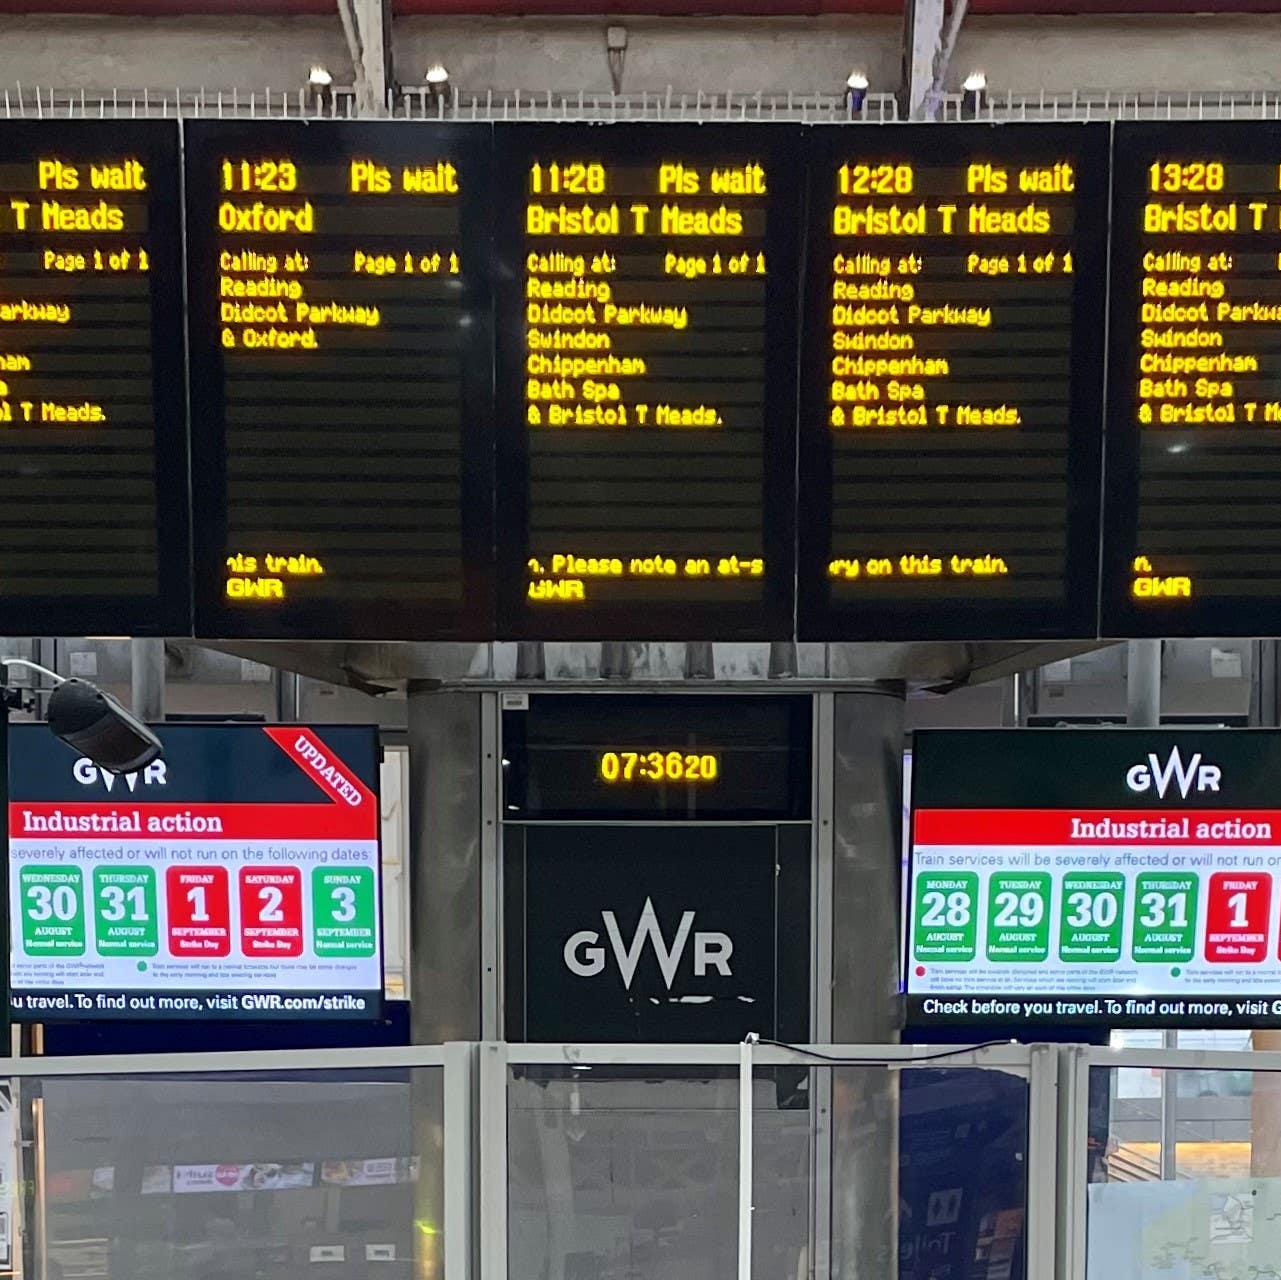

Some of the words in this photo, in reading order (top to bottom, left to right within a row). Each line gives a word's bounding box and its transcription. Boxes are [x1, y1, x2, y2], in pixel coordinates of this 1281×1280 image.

[39, 161, 79, 189] Pls
[91, 160, 146, 190] wait
[223, 160, 296, 191] 11:23
[351, 161, 391, 192] Pls
[403, 163, 458, 193] wait
[1150, 162, 1223, 191] 13:28
[11, 201, 30, 229] T
[42, 200, 123, 230] Meads
[219, 202, 313, 232] Oxford
[1145, 202, 1236, 232] Bristol
[1249, 203, 1267, 230] T
[45, 251, 85, 271] Page
[94, 250, 103, 270] 1
[109, 249, 130, 270] of
[139, 250, 148, 270] 1
[21, 402, 33, 421] T
[292, 735, 362, 807] UPDATED
[1126, 745, 1221, 799] GWR
[23, 811, 140, 832] Industrial
[146, 813, 222, 832] action
[1071, 818, 1189, 840] Industrial
[1195, 820, 1272, 840] action
[915, 852, 945, 866] Train
[949, 852, 1003, 866] services
[1009, 852, 1030, 866] will
[1034, 852, 1050, 866] be
[1055, 852, 1110, 869] severely
[1114, 852, 1169, 866] affected
[1173, 855, 1187, 866] or
[1190, 853, 1212, 866] will
[1217, 854, 1238, 866] not
[1243, 856, 1263, 866] run
[921, 892, 971, 927] 28
[994, 892, 1044, 927] 29
[1067, 892, 1117, 927] 30
[1140, 892, 1188, 927] 31
[1228, 892, 1249, 927] 1
[564, 896, 733, 991] GWR
[923, 999, 968, 1014] Check
[972, 999, 1020, 1014] before
[1024, 1002, 1053, 1018] you
[1056, 999, 1102, 1014] travel.
[1104, 999, 1122, 1014] To
[1125, 998, 1155, 1014] find
[1159, 1001, 1184, 1014] out
[1188, 1002, 1233, 1017] more,
[1236, 1000, 1268, 1014] visit
